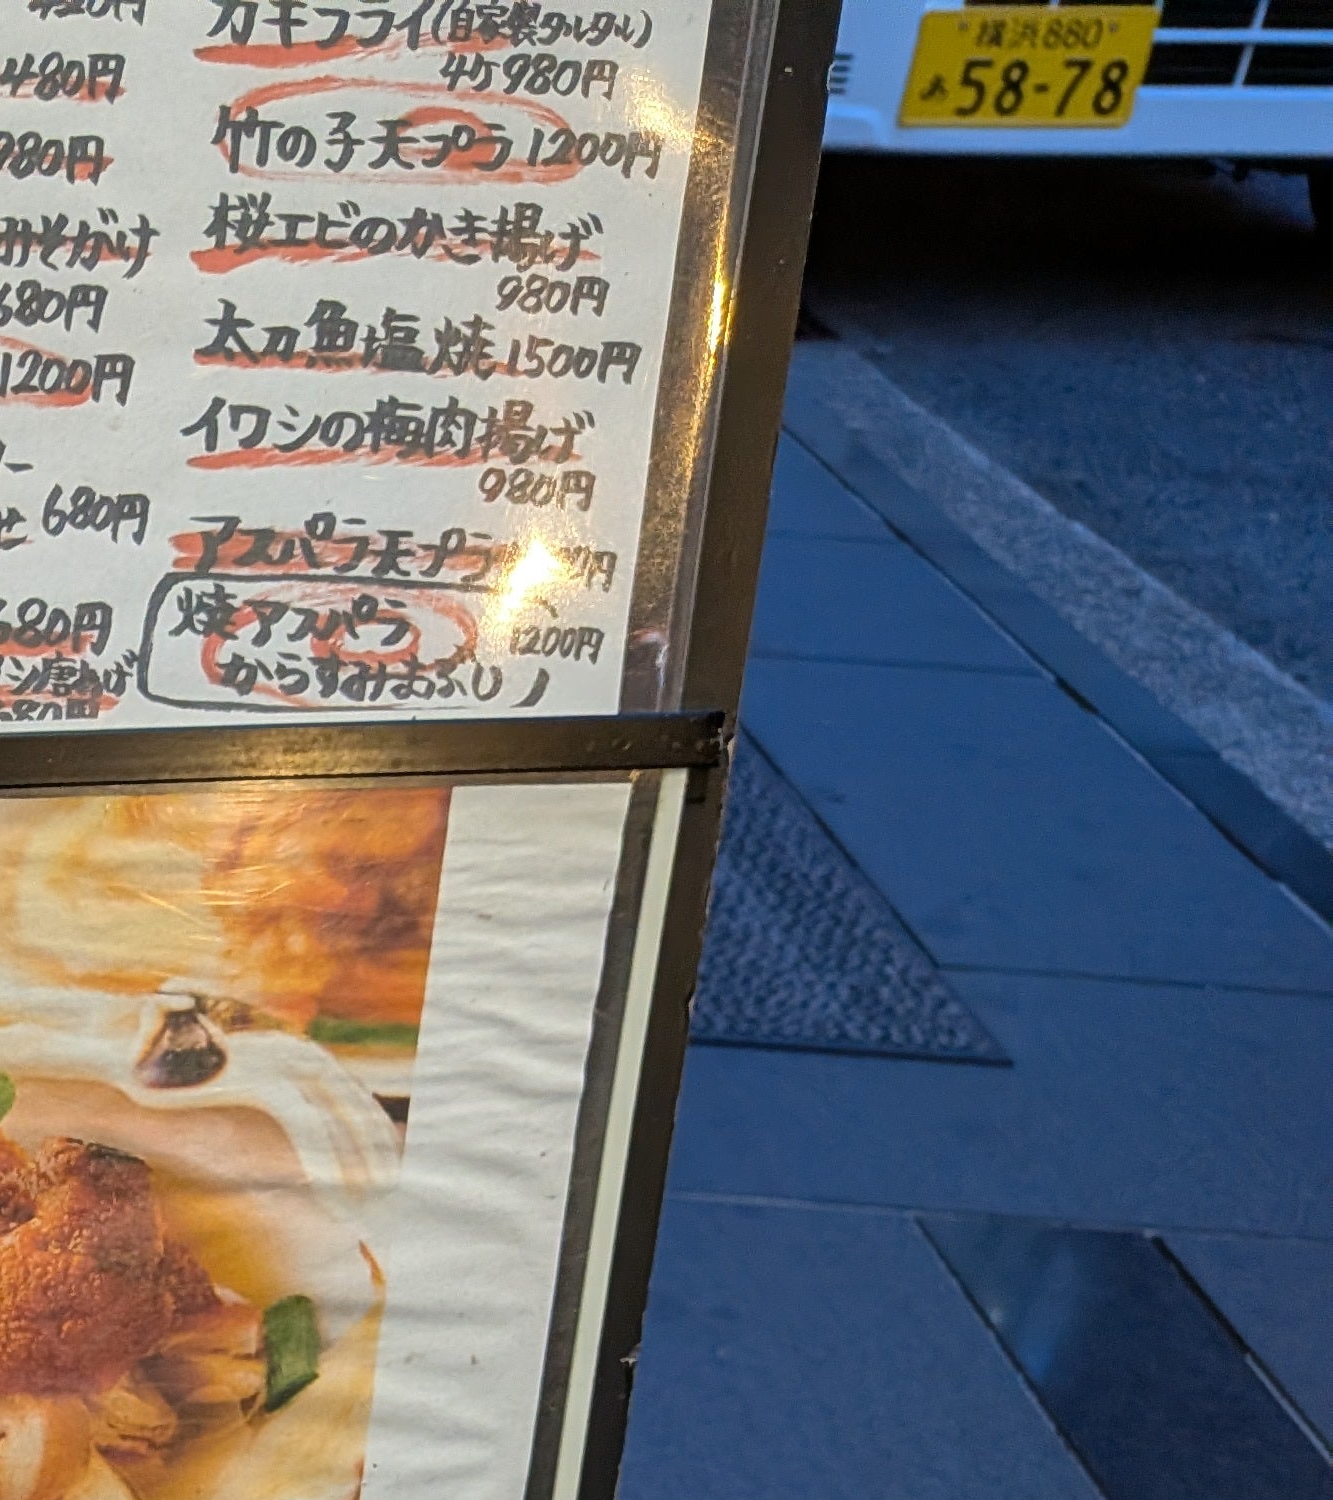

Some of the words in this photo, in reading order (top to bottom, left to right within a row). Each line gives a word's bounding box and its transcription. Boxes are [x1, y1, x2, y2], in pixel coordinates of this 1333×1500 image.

[954, 57, 1130, 117] 58-78
[210, 104, 513, 174] 竹の子天プラ
[527, 129, 662, 179] 1200円
[202, 191, 604, 273] 桜エビのかき揚げ
[497, 274, 610, 317] 980円
[195, 297, 498, 381] 太刀魚塩焼
[507, 340, 642, 384] 1500円
[181, 395, 595, 465] イワシの梅肉揚げ
[41, 483, 150, 545] 680円
[478, 466, 596, 512] 980円
[169, 583, 411, 648] 焼アスパラ
